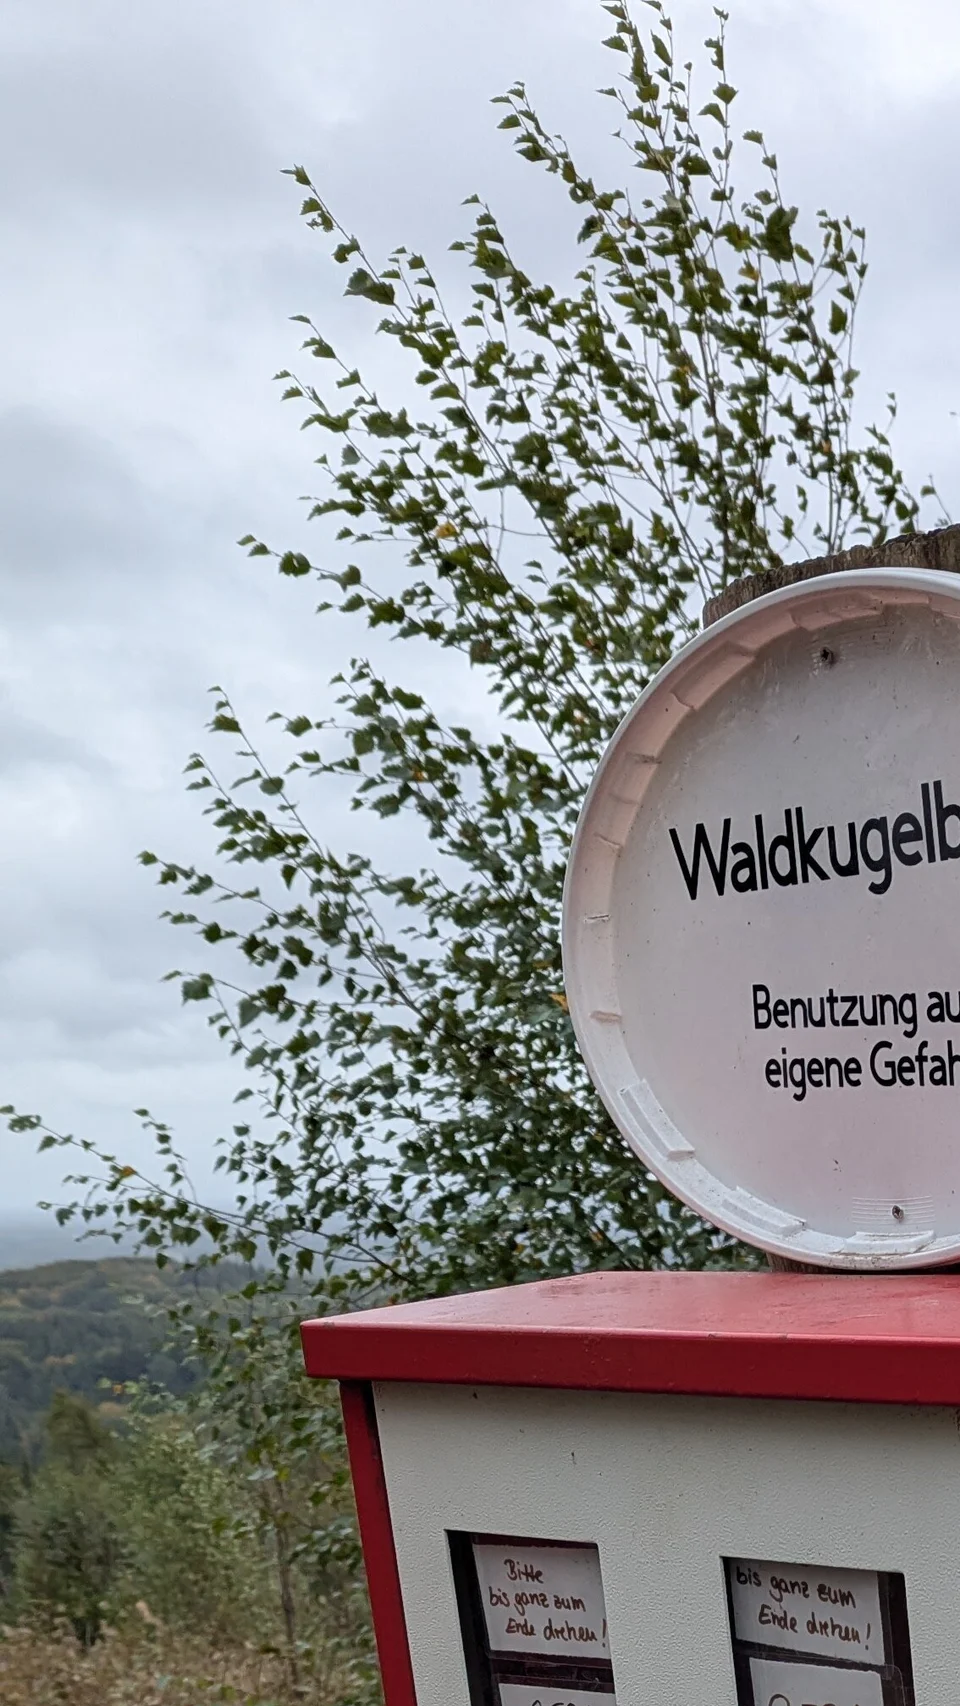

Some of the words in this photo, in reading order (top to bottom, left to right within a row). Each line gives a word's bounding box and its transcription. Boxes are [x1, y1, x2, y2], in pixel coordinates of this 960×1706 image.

[752, 984, 918, 1038] Benutzung
[764, 1046, 863, 1102] eigene
[503, 1558, 544, 1584] Bitte
[736, 1566, 762, 1587] bis
[769, 1575, 810, 1603] ganz
[488, 1586, 511, 1607] bis
[513, 1592, 550, 1616] ganz
[553, 1594, 586, 1612] zum
[505, 1618, 537, 1637] Ende
[758, 1603, 798, 1633] Ende
